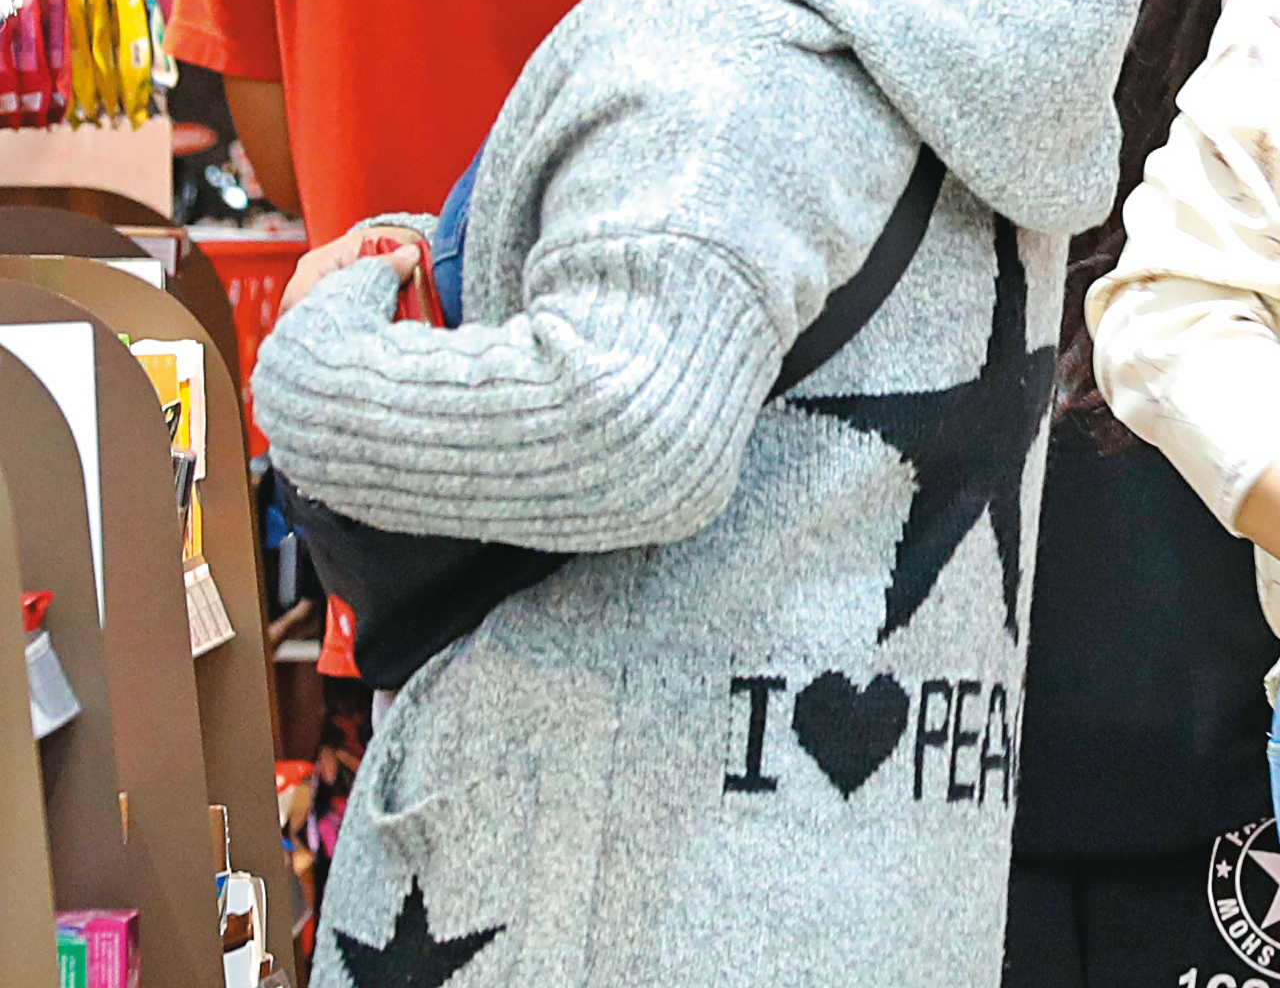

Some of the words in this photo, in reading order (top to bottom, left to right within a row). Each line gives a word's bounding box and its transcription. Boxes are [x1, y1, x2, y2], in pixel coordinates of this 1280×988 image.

[723, 675, 787, 794] I
[914, 677, 1014, 809] PEA
[1216, 897, 1276, 967] SHOW
